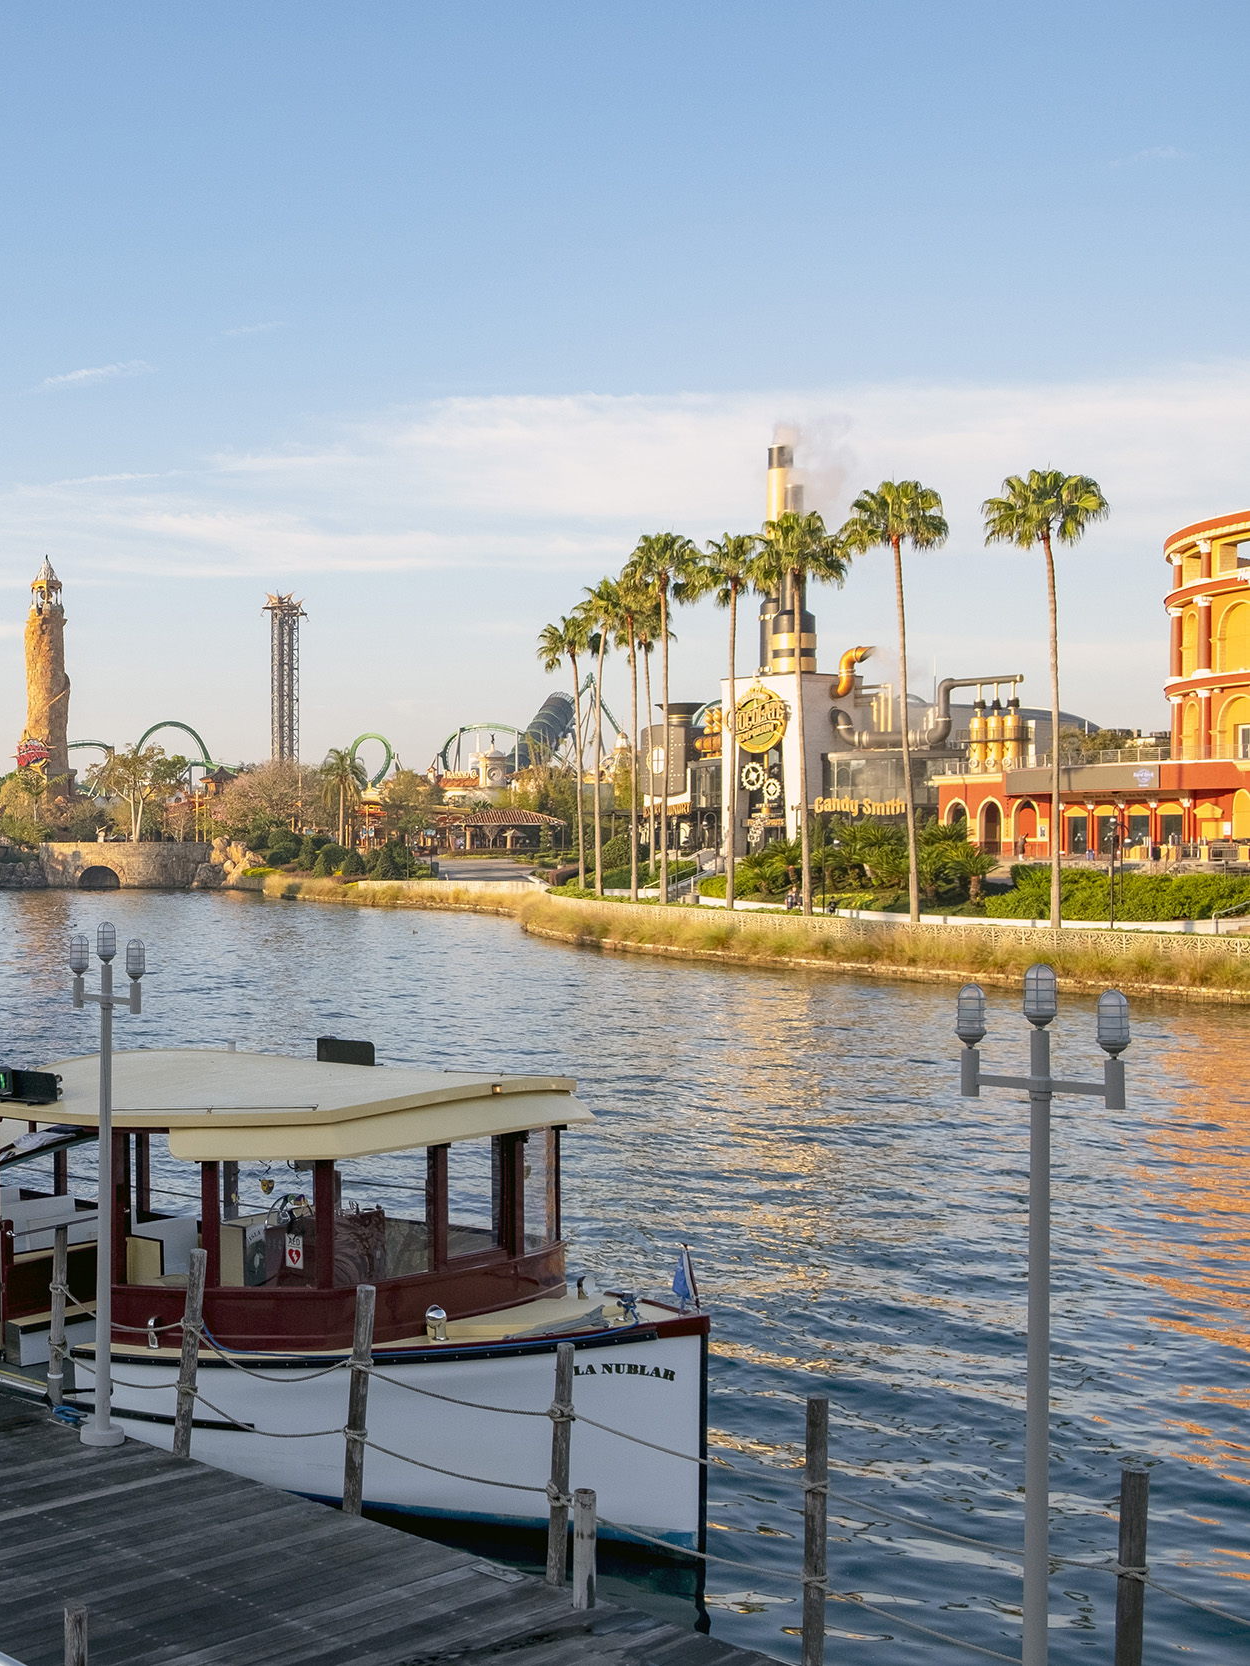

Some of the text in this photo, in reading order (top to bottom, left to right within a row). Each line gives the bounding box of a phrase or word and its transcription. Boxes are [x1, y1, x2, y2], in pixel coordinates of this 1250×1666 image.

[814, 795, 906, 817] Candy Smith
[573, 1363, 676, 1381] LA NUBLAR
